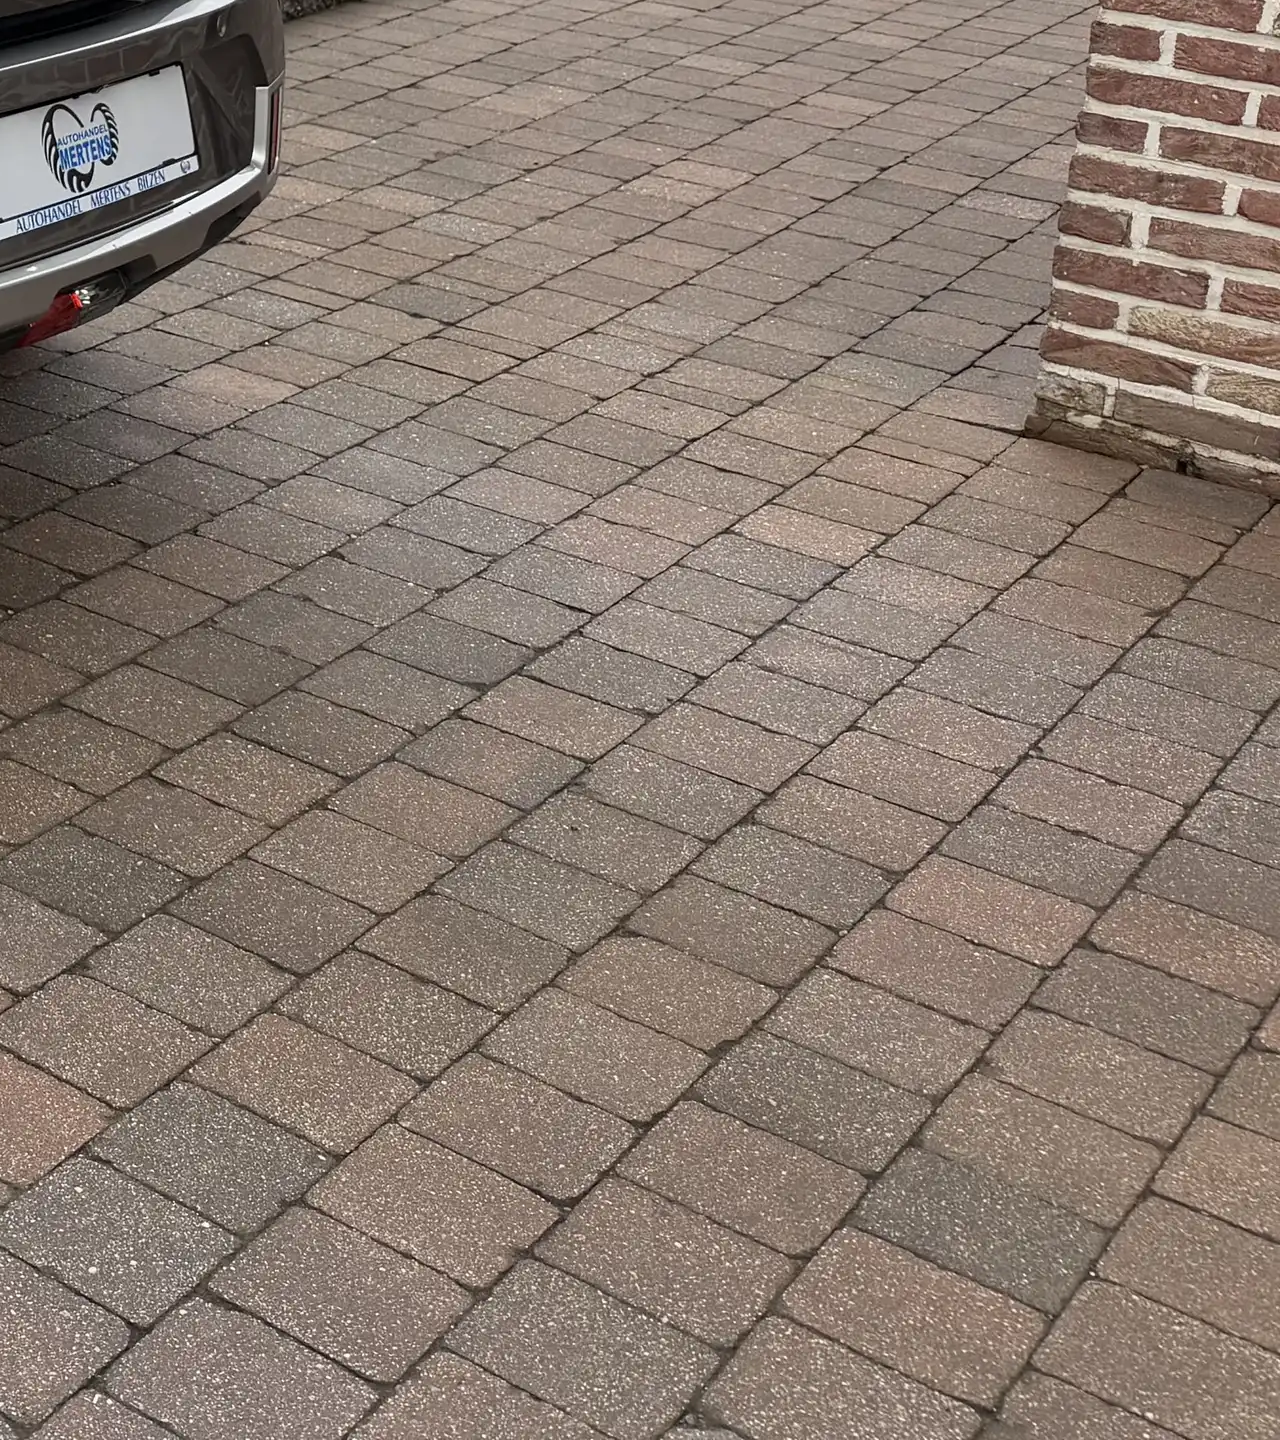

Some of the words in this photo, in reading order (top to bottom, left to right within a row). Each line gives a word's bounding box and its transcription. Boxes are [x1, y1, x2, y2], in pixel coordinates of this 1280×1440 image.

[57, 124, 108, 146] AUTOHANDEL
[59, 135, 111, 171] MERTENS
[15, 199, 83, 234] AUTOHANDEL
[90, 182, 131, 209] MERTENS
[137, 169, 166, 191] BILZEN
